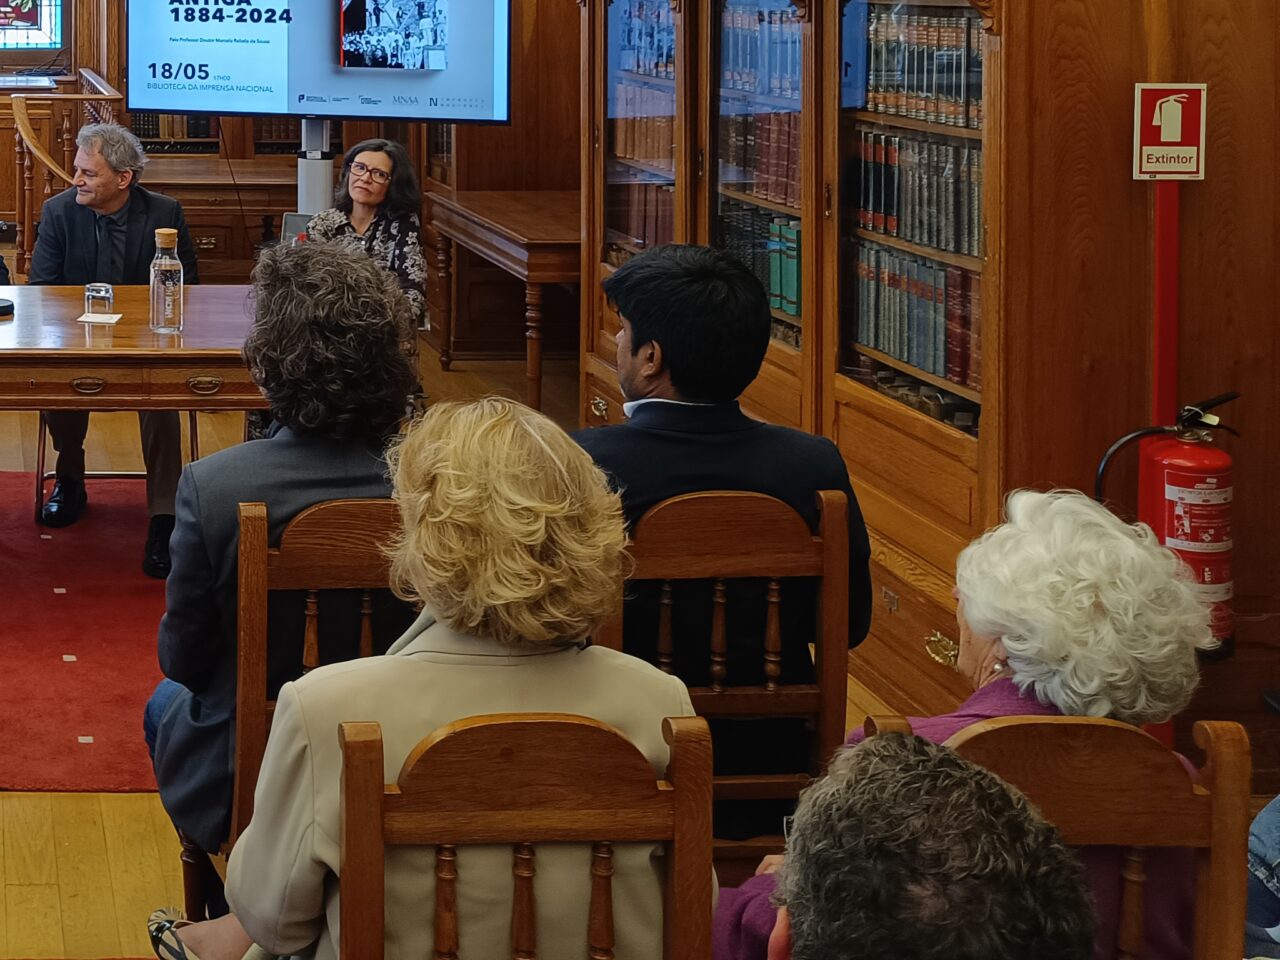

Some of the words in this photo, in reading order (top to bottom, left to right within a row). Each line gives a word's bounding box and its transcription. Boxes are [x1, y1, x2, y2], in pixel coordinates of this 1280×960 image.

[148, 62, 210, 80] 18/05
[147, 82, 187, 91] BIBLIOTECA
[188, 83, 198, 91] DA
[199, 83, 235, 92] IMPRENSA
[235, 84, 274, 93] NACIONAL
[1146, 153, 1194, 164] Extintor
